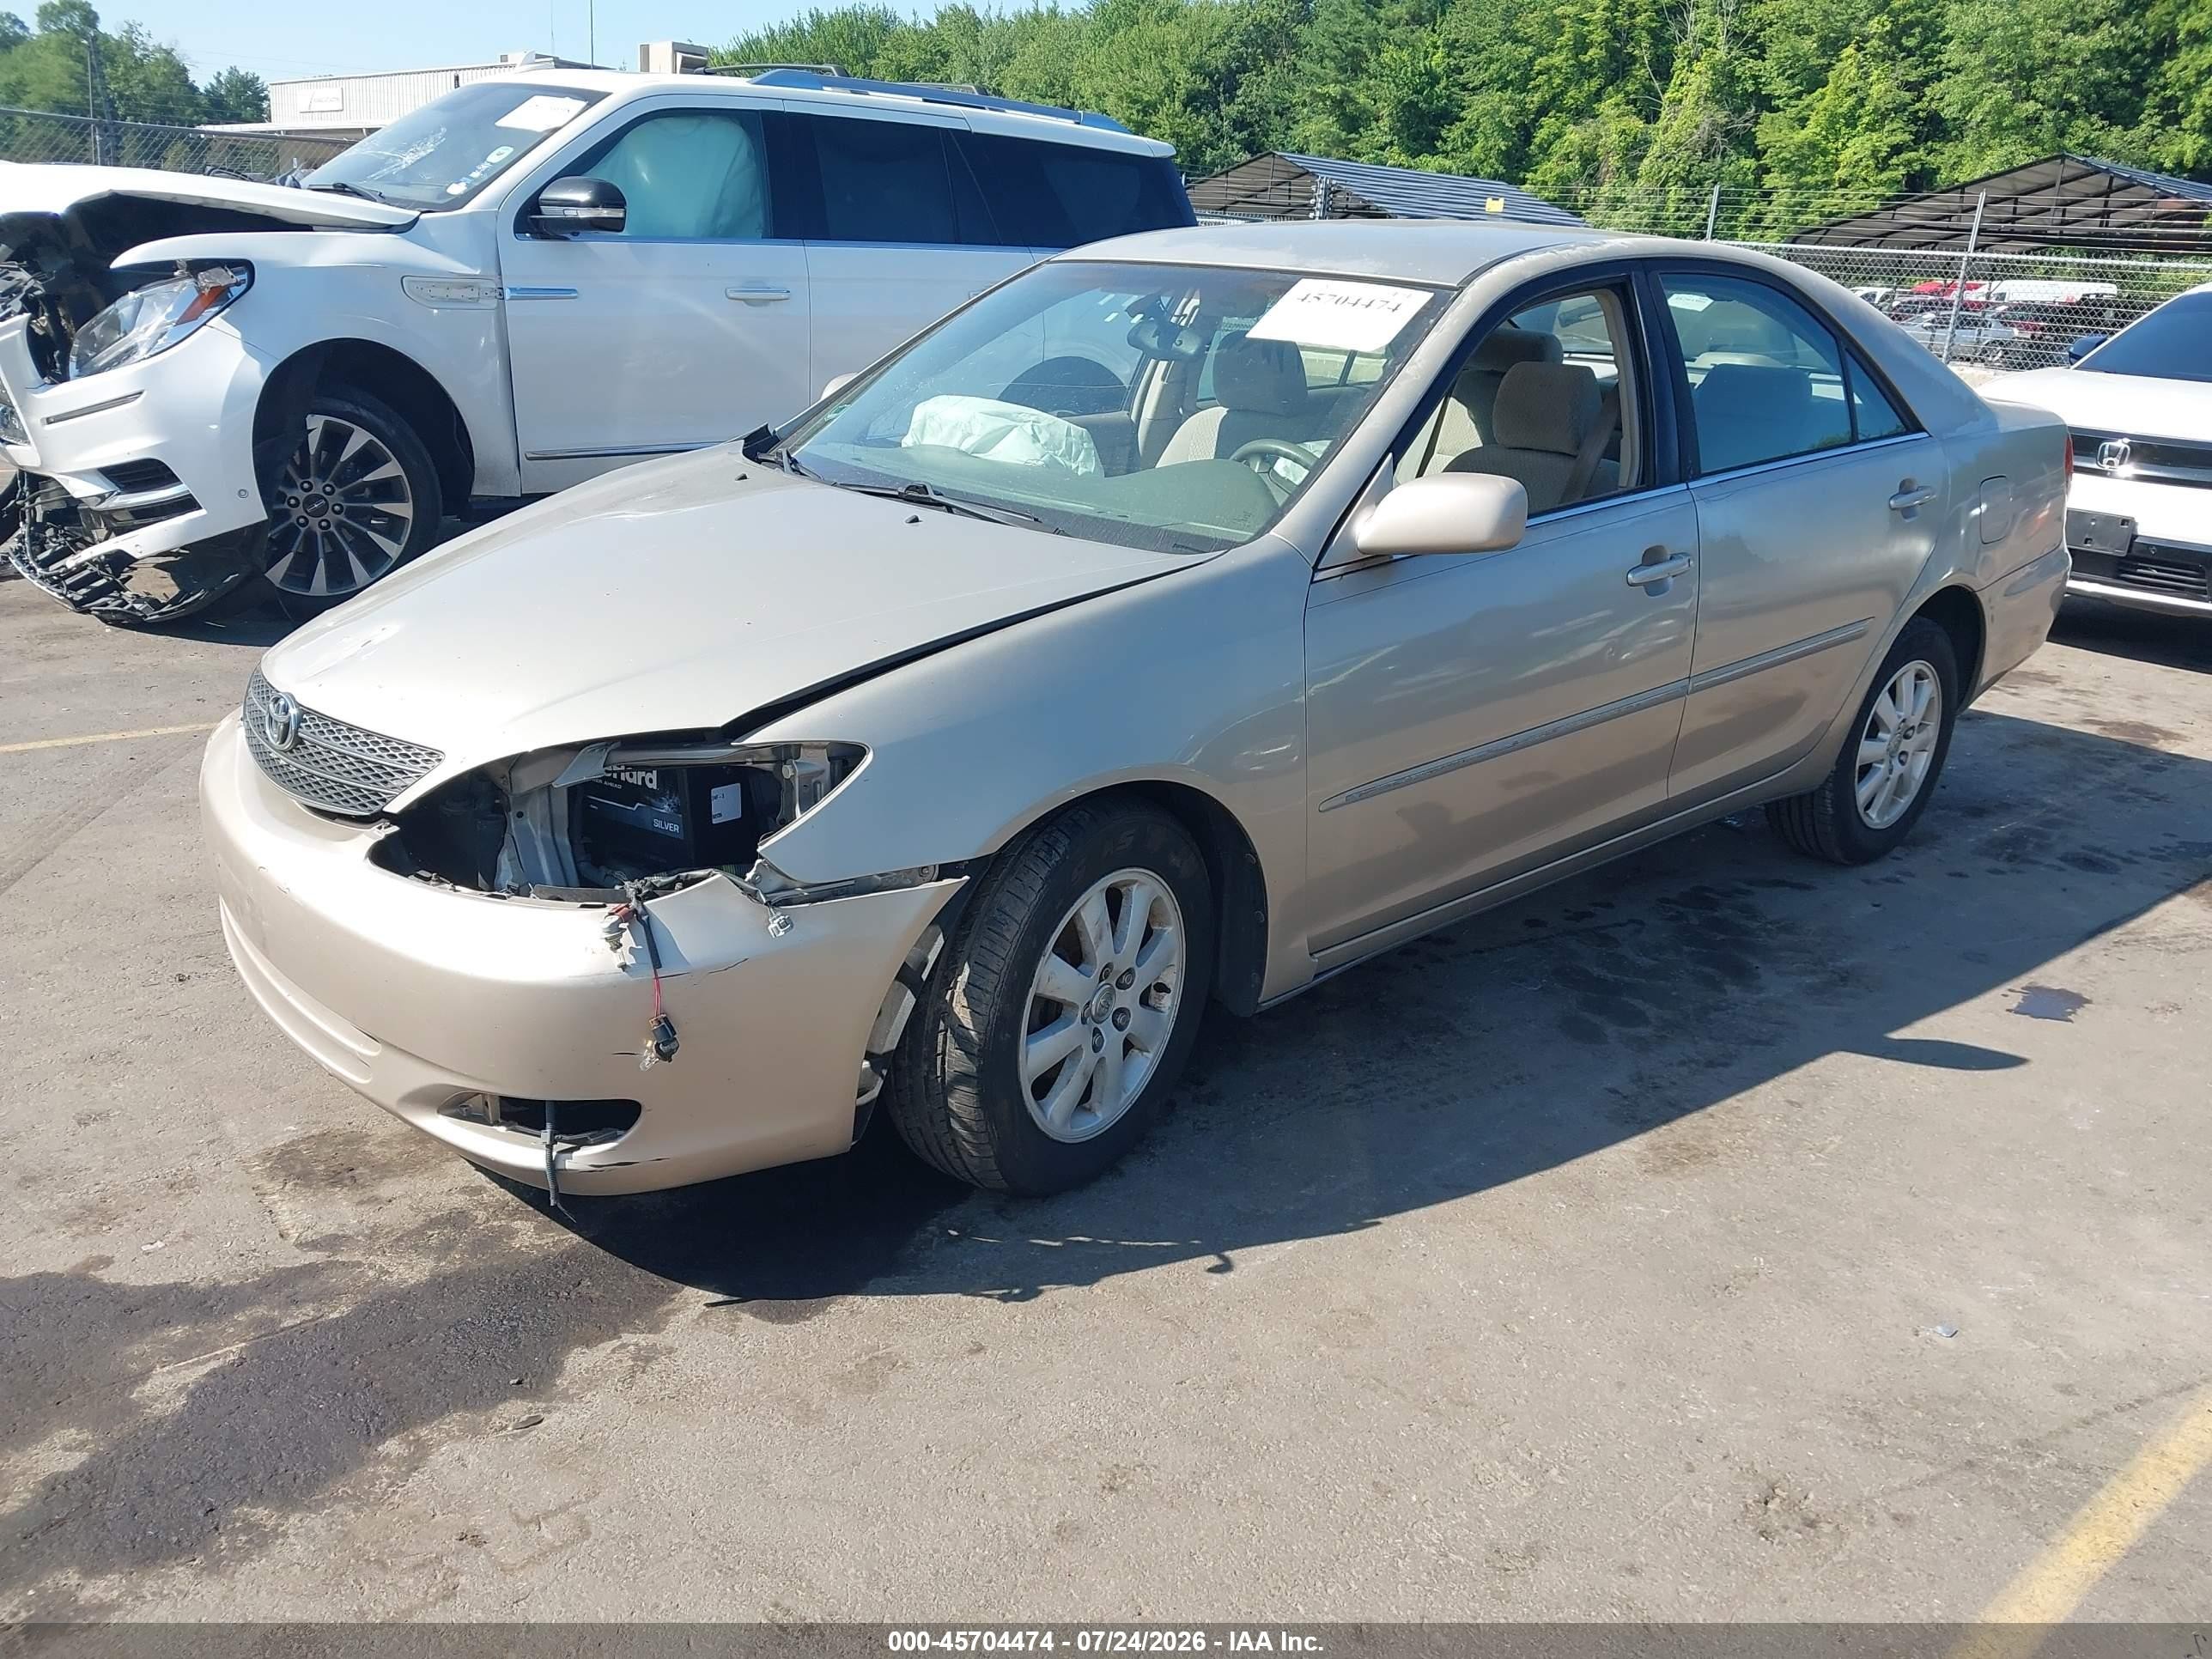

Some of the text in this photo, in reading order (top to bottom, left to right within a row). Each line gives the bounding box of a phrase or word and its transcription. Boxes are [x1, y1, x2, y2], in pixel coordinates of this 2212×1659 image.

[1296, 292, 1402, 313] 45704474
[604, 765, 657, 789] eHard
[653, 817, 679, 834] SILVER
